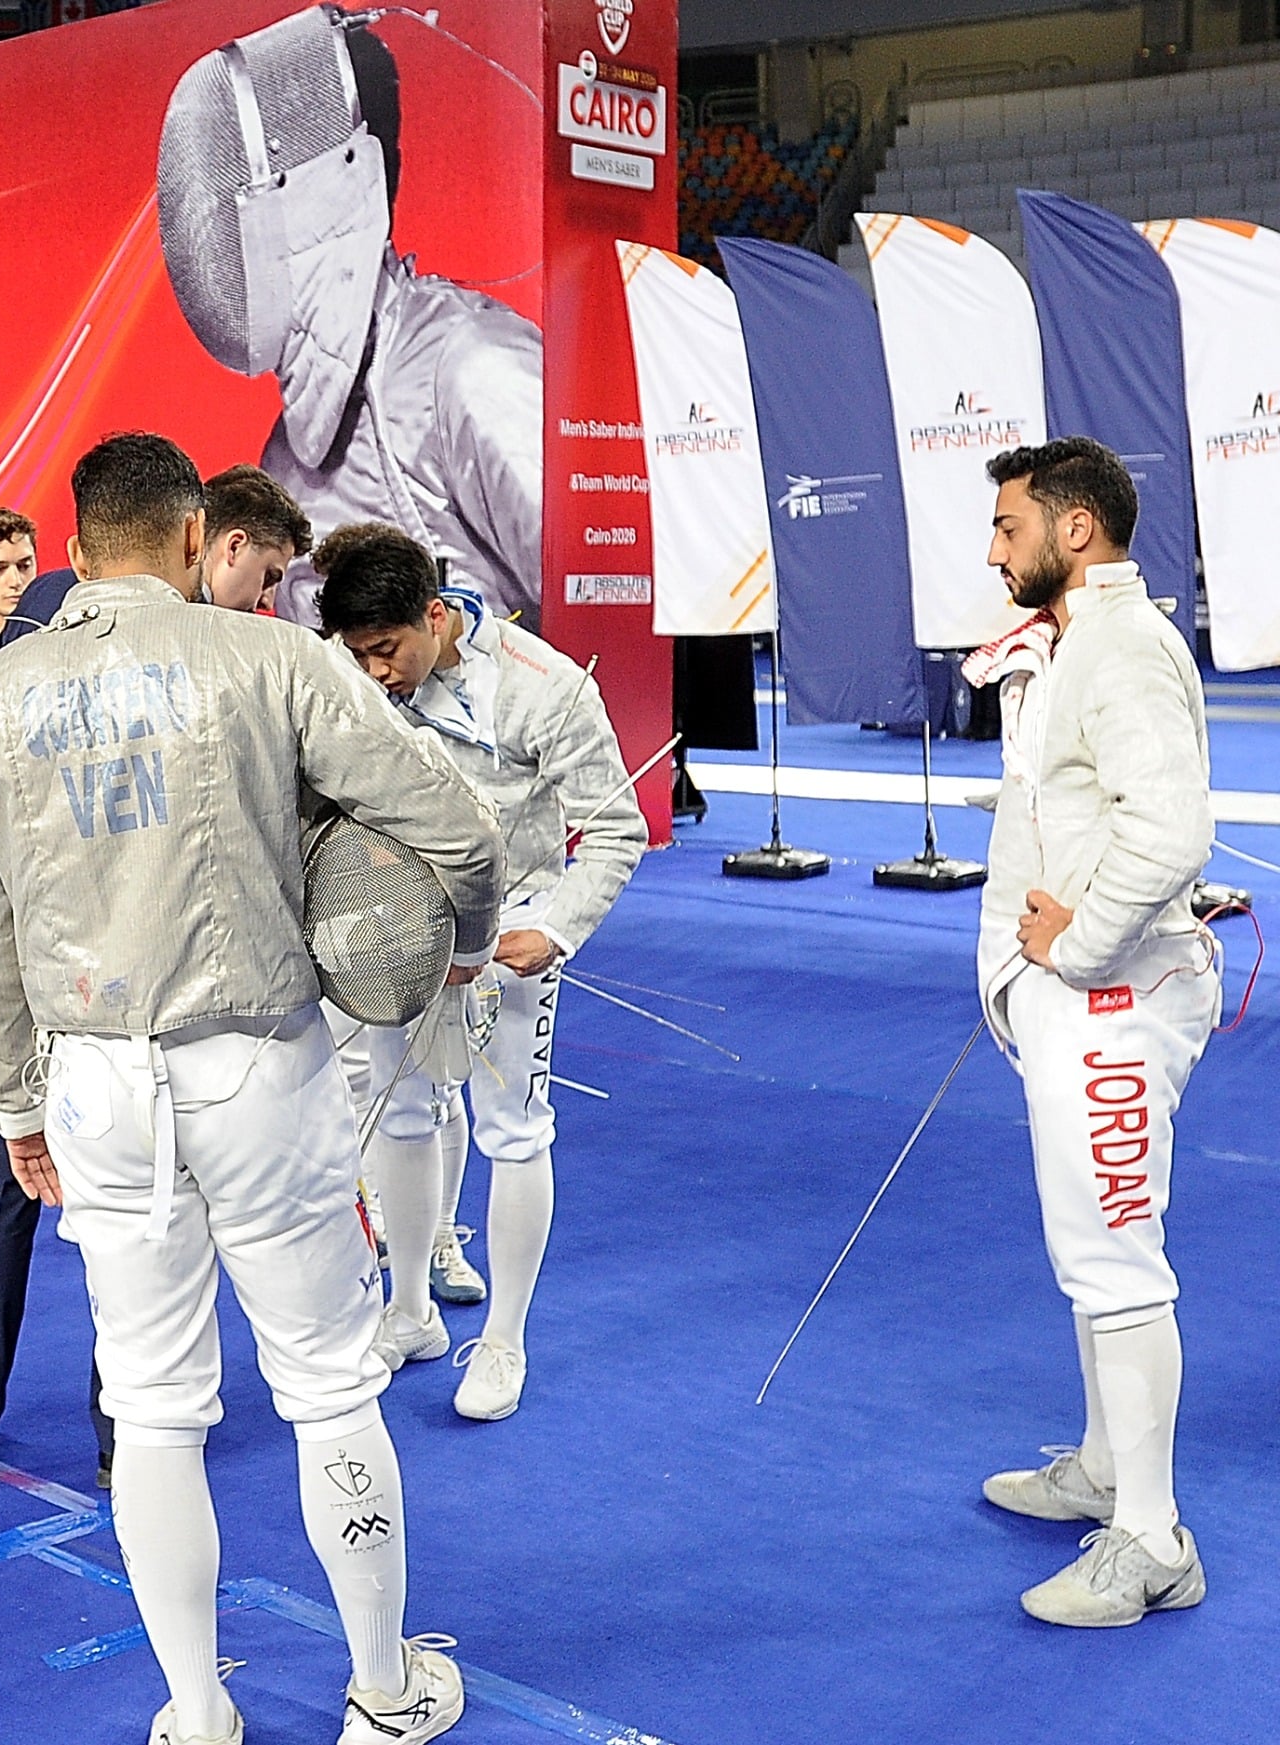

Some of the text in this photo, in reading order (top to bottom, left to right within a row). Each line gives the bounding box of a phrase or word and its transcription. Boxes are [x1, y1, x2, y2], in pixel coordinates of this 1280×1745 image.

[603, 8, 624, 26] CUP
[570, 81, 658, 138] CAIRO
[560, 417, 588, 438] Men's
[589, 419, 617, 439] Saber
[603, 474, 631, 493] World
[788, 494, 821, 519] FIE
[584, 526, 637, 546] Cairo 2026
[594, 576, 648, 588] ABSOLUTE
[594, 587, 648, 600] FENCING
[60, 750, 169, 839] VEN
[523, 961, 563, 1122] JAPAN
[1082, 1051, 1153, 1229] JORDAN
